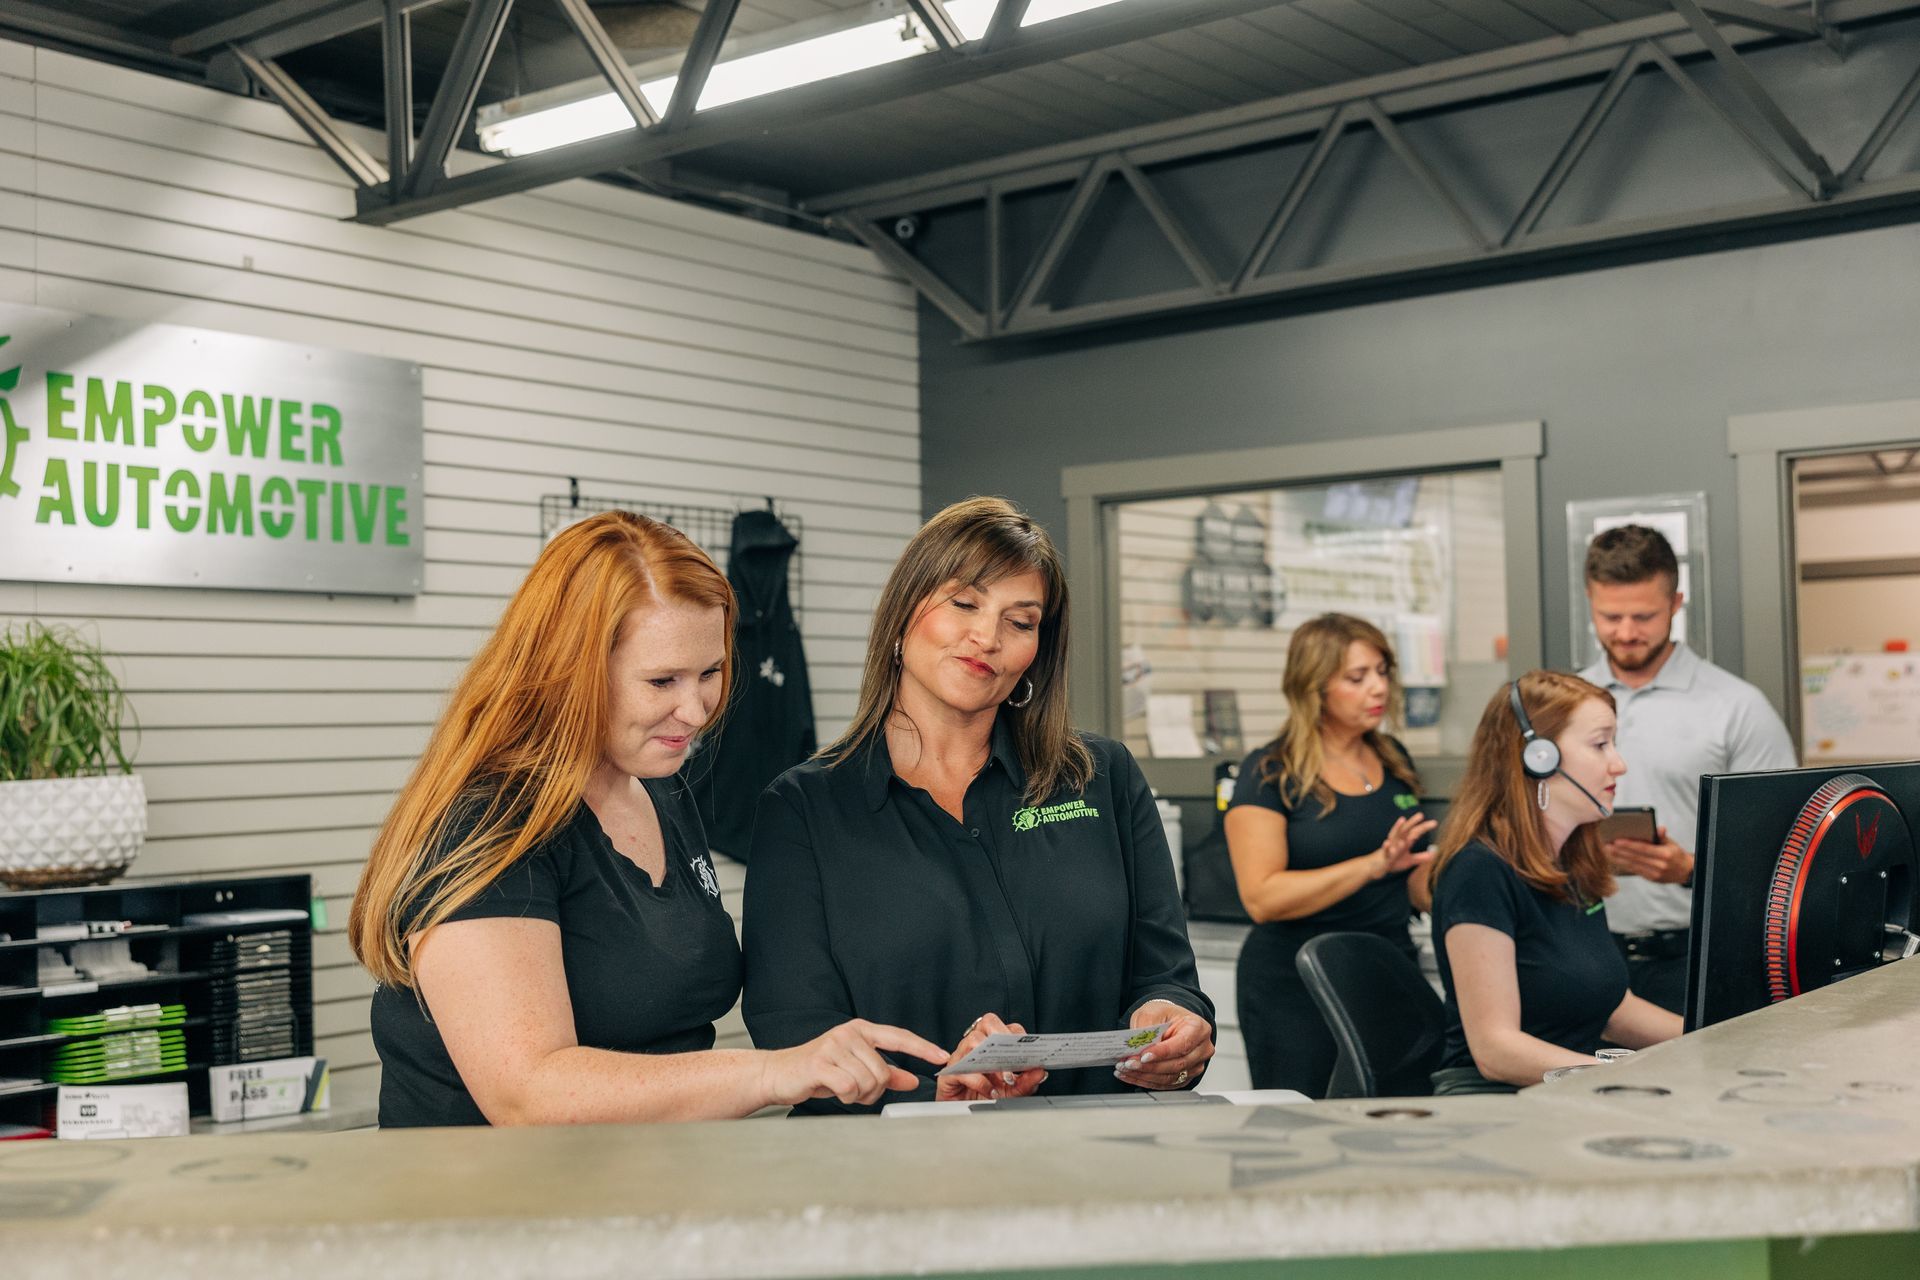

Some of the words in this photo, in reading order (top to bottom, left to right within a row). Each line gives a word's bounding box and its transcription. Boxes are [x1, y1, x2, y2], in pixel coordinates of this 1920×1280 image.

[46, 370, 343, 467] EMPOWER
[35, 458, 410, 547] AUTOMOTIVE
[1041, 800, 1086, 815] EMPOWER
[1042, 808, 1100, 824] AUTOMOTIVE
[229, 1067, 264, 1082] FREE
[230, 1086, 268, 1102] PASS
